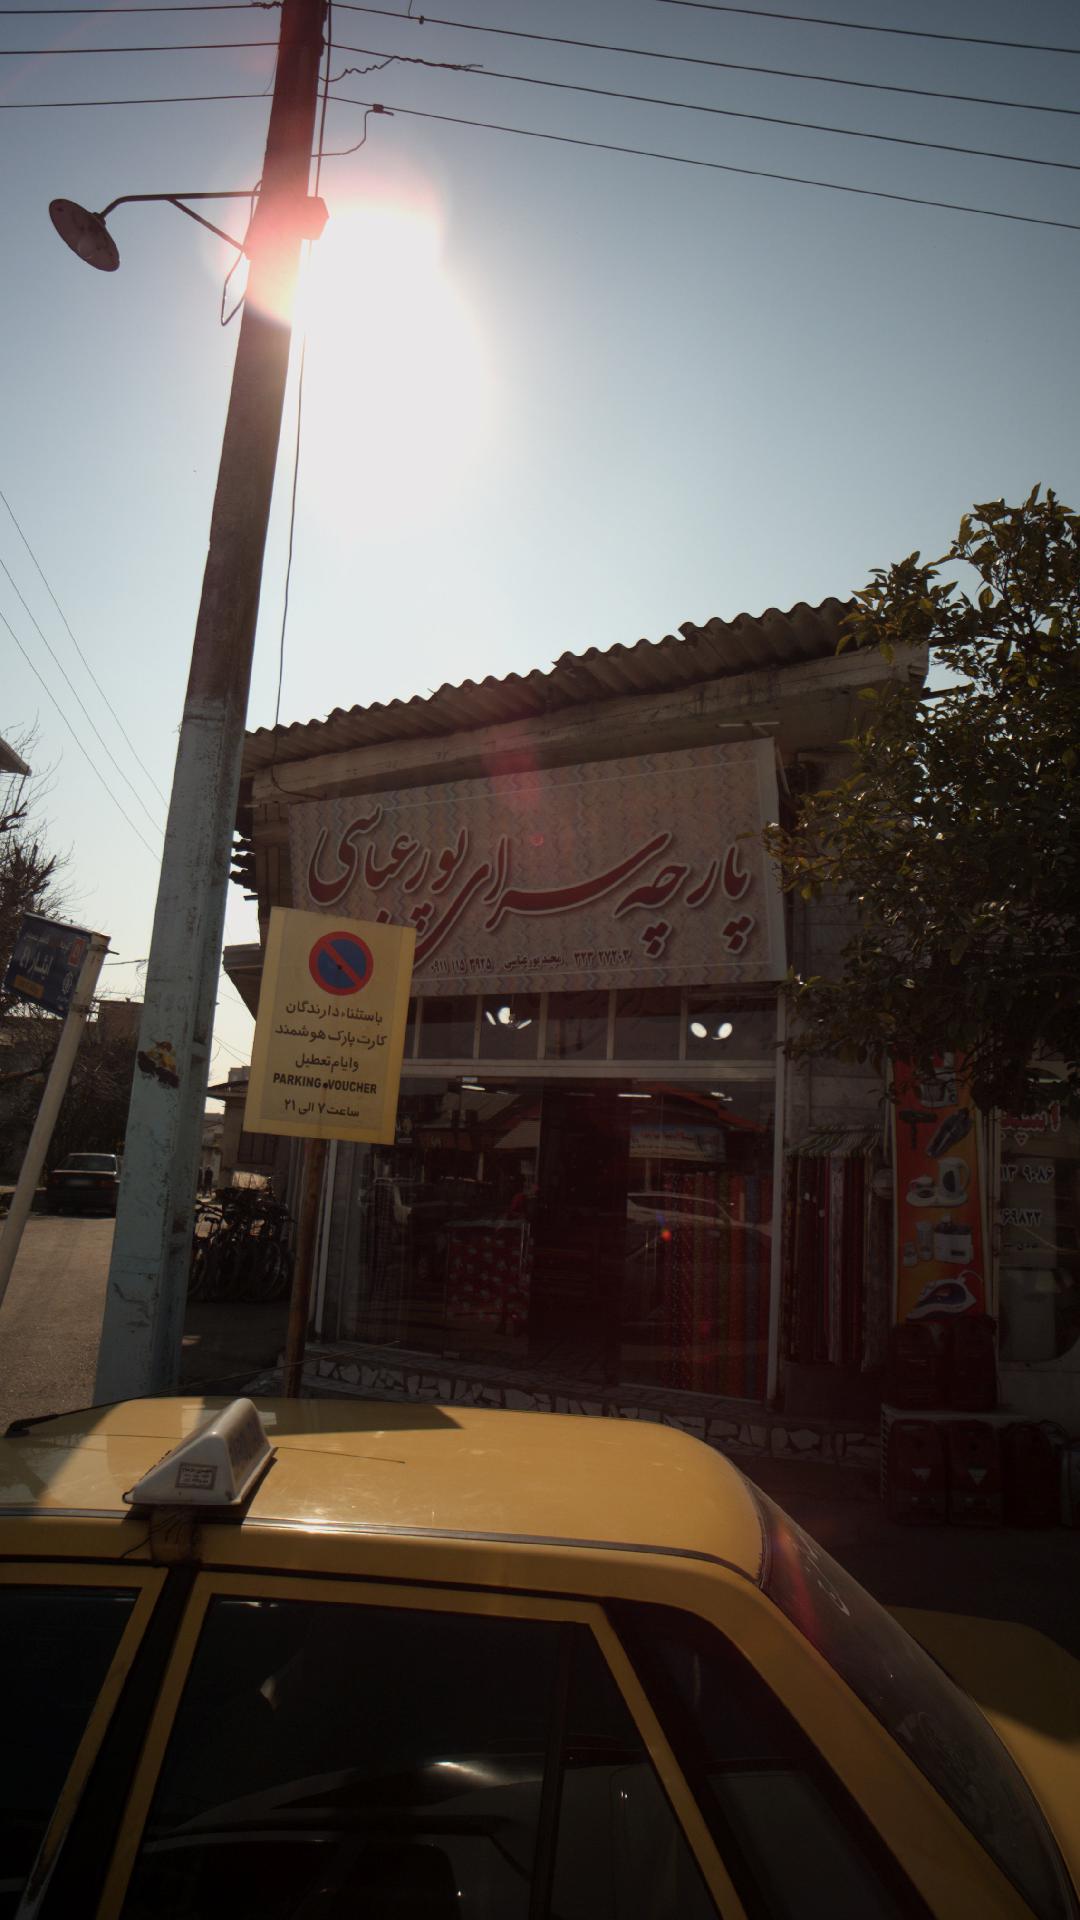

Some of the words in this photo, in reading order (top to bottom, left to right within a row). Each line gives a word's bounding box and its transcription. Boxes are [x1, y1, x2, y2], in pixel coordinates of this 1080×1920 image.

[412, 830, 673, 970] سرای
[611, 842, 754, 958] پارچه
[286, 1000, 339, 1019] دارندگان
[274, 1024, 327, 1042] هوشمند
[329, 1030, 356, 1048] پارک
[358, 1035, 388, 1050] کارت
[295, 1053, 332, 1069] تعطیل
[272, 1072, 322, 1089] PARKING
[328, 1080, 377, 1095] VOUCHER
[284, 1098, 297, 1112] ۲۱
[298, 1100, 315, 1116] الی
[317, 1103, 326, 1114] ۷
[326, 1103, 360, 1118] ساعت
